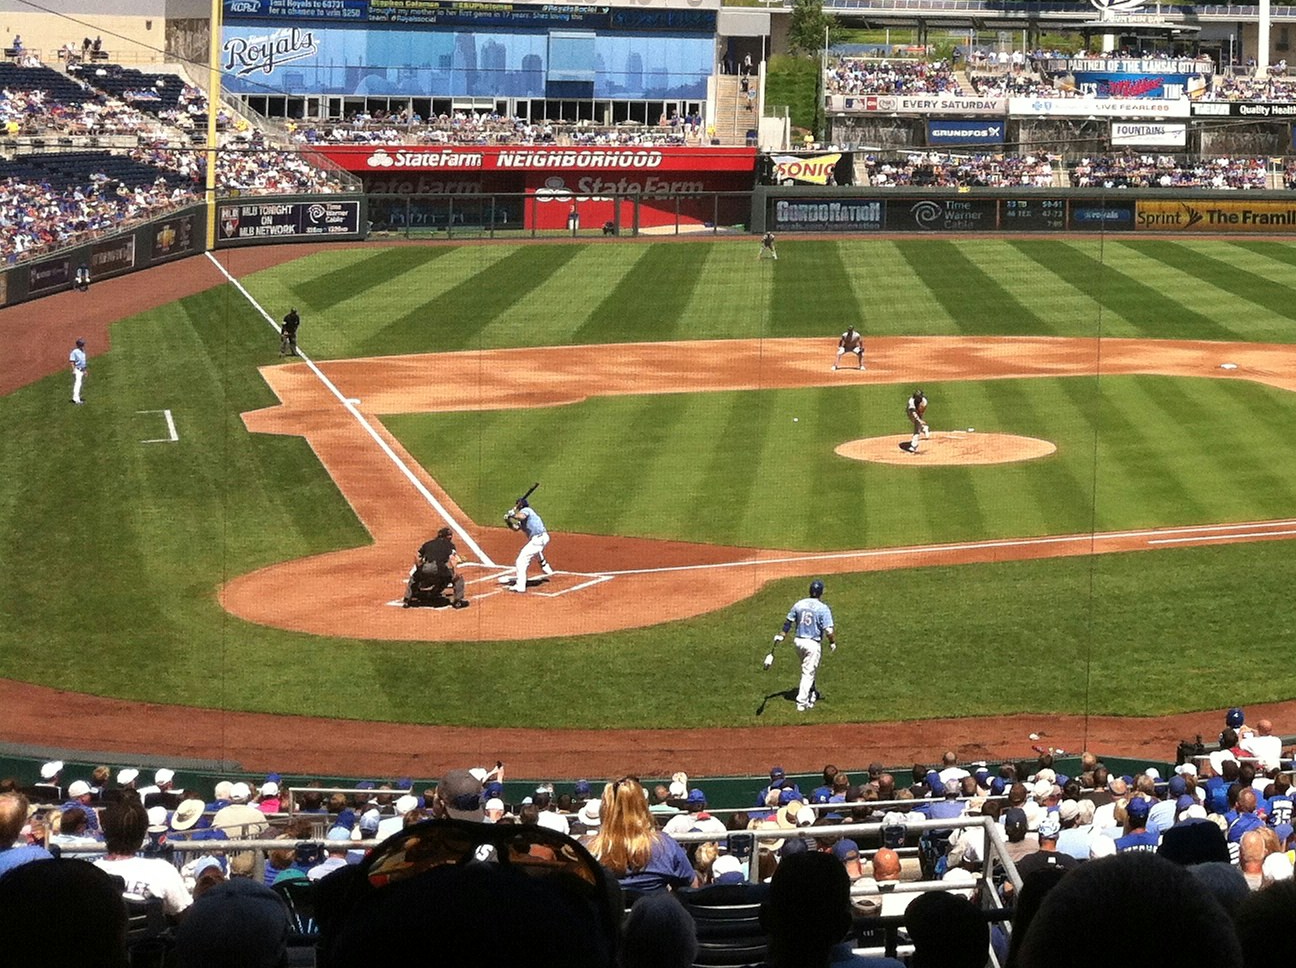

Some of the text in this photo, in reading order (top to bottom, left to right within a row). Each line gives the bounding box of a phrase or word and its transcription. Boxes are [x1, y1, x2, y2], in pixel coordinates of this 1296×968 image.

[224, 27, 317, 76] Royals
[1068, 60, 1106, 71] PARTNER
[1107, 61, 1120, 71] OF
[1122, 61, 1140, 72] THE
[1142, 61, 1177, 72] KANSAS
[1178, 62, 1195, 73] CITY
[902, 100, 938, 109] EVERY
[941, 100, 998, 110] SATURDAY
[1239, 105, 1270, 115] Quality
[932, 129, 988, 137] GRUNDFOS
[1117, 126, 1165, 135] FOUNTAINS
[497, 150, 662, 168] NEIGHBORHOOD
[776, 163, 836, 177] SONIC
[260, 205, 293, 215] TONIGHT
[945, 201, 971, 210] Time
[944, 210, 983, 220] Warner
[1137, 212, 1182, 230] Sprint
[1206, 210, 1239, 225] The
[261, 216, 273, 225] ON
[256, 225, 296, 235] NETWORK
[1272, 809, 1292, 827] 35
